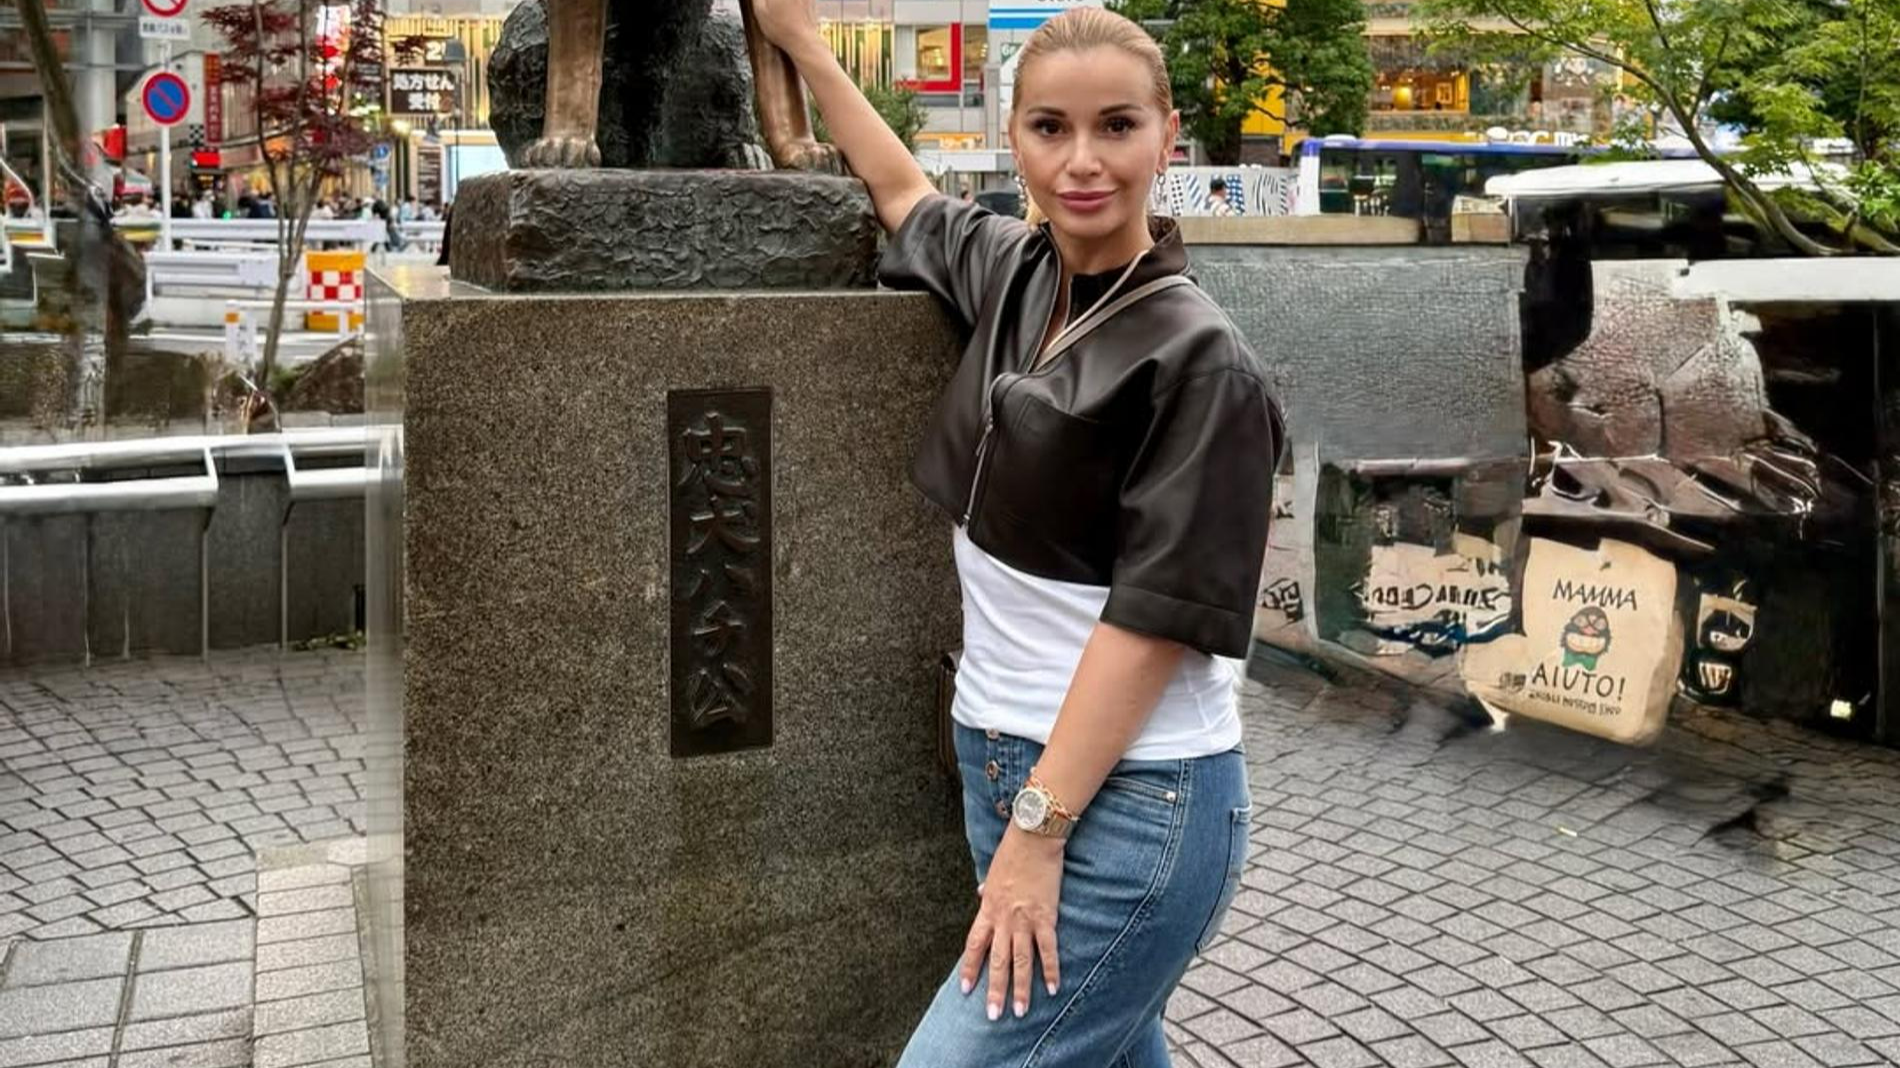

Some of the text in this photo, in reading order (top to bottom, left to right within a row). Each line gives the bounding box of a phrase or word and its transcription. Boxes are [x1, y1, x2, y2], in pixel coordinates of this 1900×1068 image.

[393, 73, 455, 91] 処方せん
[408, 92, 441, 110] 受付
[678, 410, 761, 722] 忠犬ハチ公
[1552, 578, 1638, 612] MAMMA
[1532, 661, 1627, 701] AIUTO!
